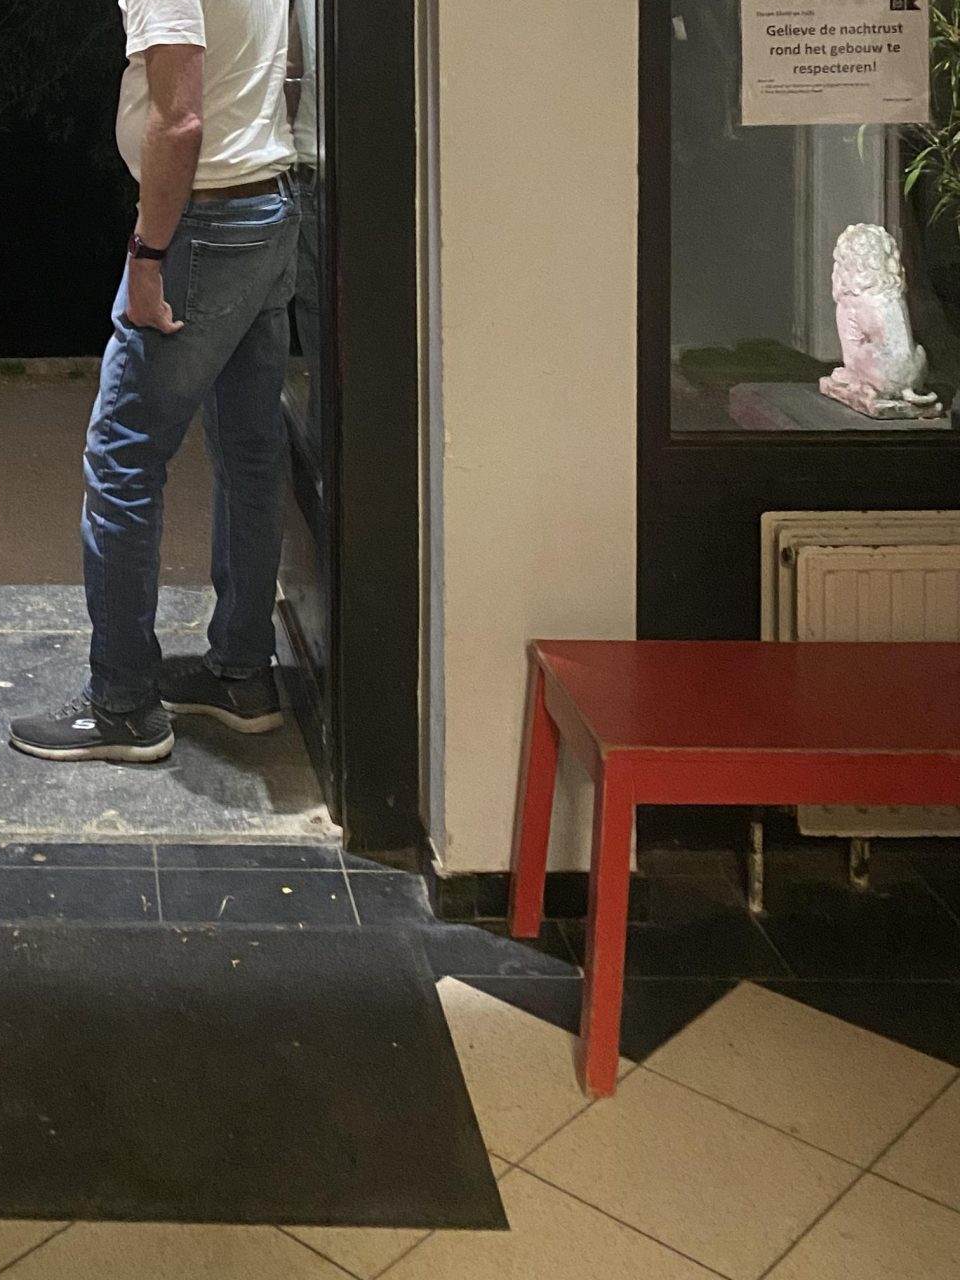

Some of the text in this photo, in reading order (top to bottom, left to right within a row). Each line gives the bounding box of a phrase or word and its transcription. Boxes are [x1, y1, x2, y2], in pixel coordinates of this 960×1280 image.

[766, 22, 904, 37] Gelieve de nachtrust
[769, 42, 901, 57] rond het gebouw te
[792, 61, 877, 76] respecteren!
